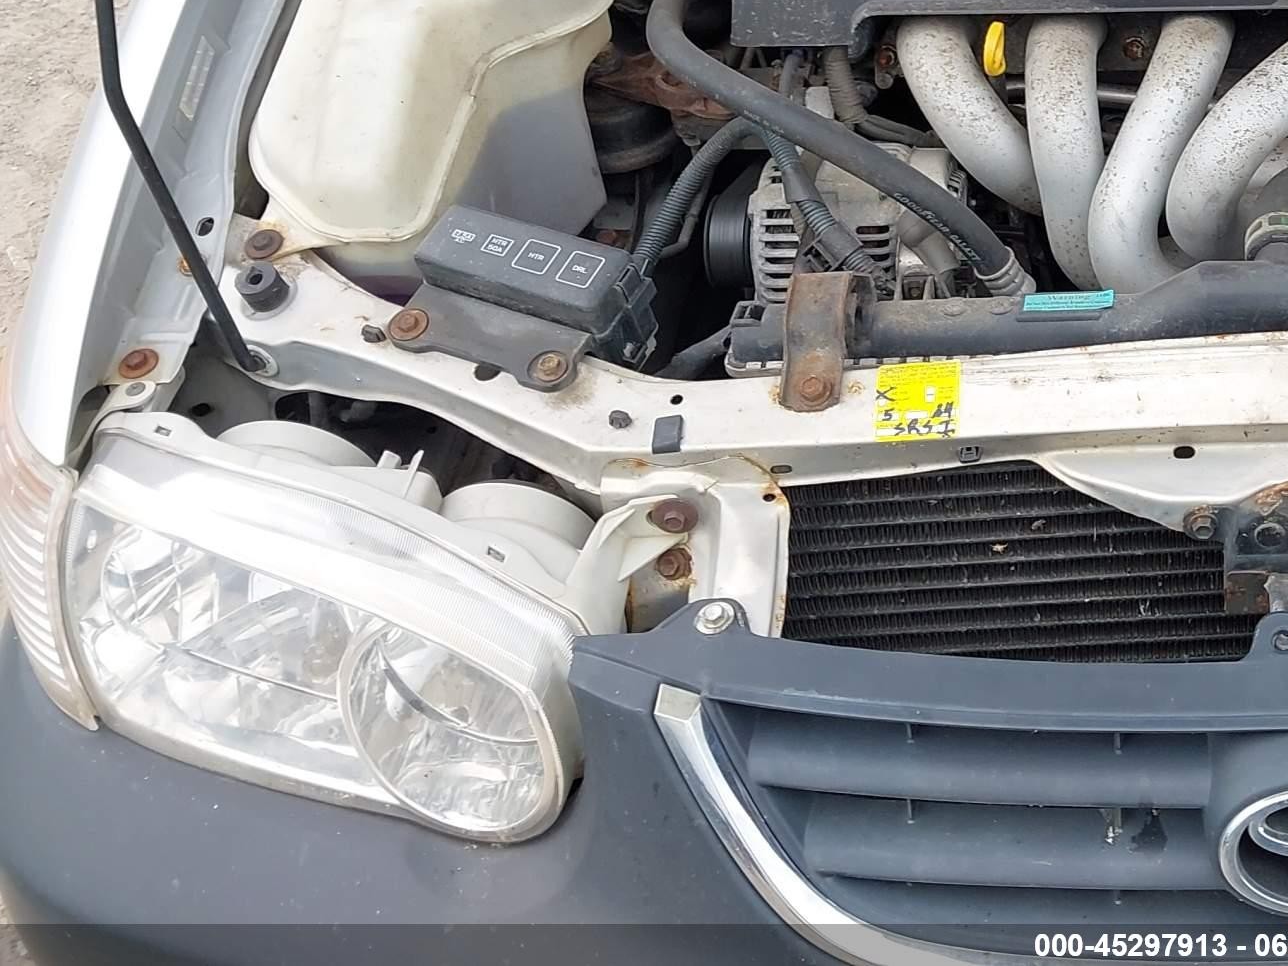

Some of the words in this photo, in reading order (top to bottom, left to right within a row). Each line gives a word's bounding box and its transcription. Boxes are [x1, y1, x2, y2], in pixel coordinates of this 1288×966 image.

[895, 192, 950, 233] GOODYEAR
[491, 237, 508, 246] HTR
[527, 251, 545, 262] HTR
[572, 264, 588, 274] DRL
